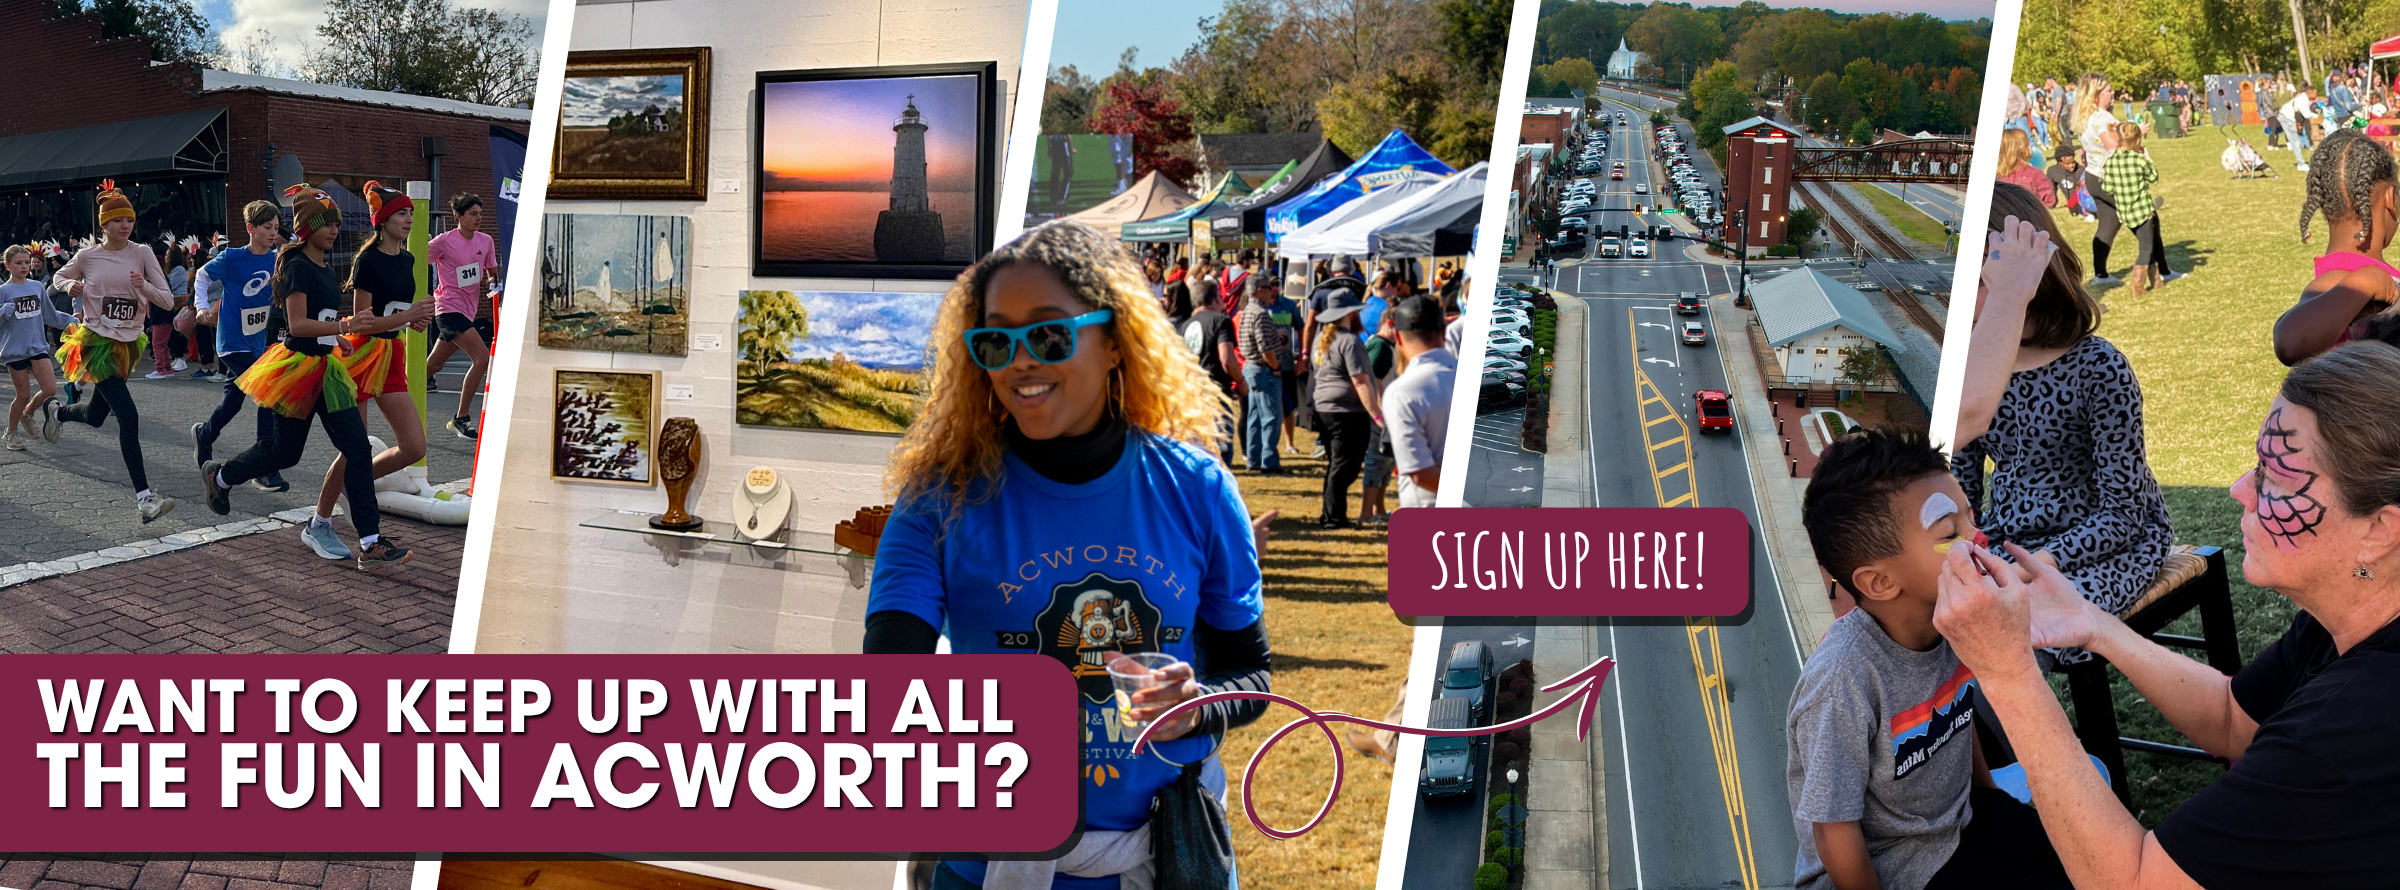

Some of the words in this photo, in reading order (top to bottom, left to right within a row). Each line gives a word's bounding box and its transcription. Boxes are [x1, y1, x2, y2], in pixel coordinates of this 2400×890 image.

[1890, 160, 1971, 175] ACWO
[461, 267, 477, 280] 314
[17, 299, 36, 313] 1449
[107, 303, 134, 319] 1450
[247, 311, 267, 326] 686
[998, 545, 1186, 604] ACWORTH
[1003, 633, 1028, 645] 20
[1165, 628, 1182, 640] 23
[1079, 748, 1139, 759] STIVA
